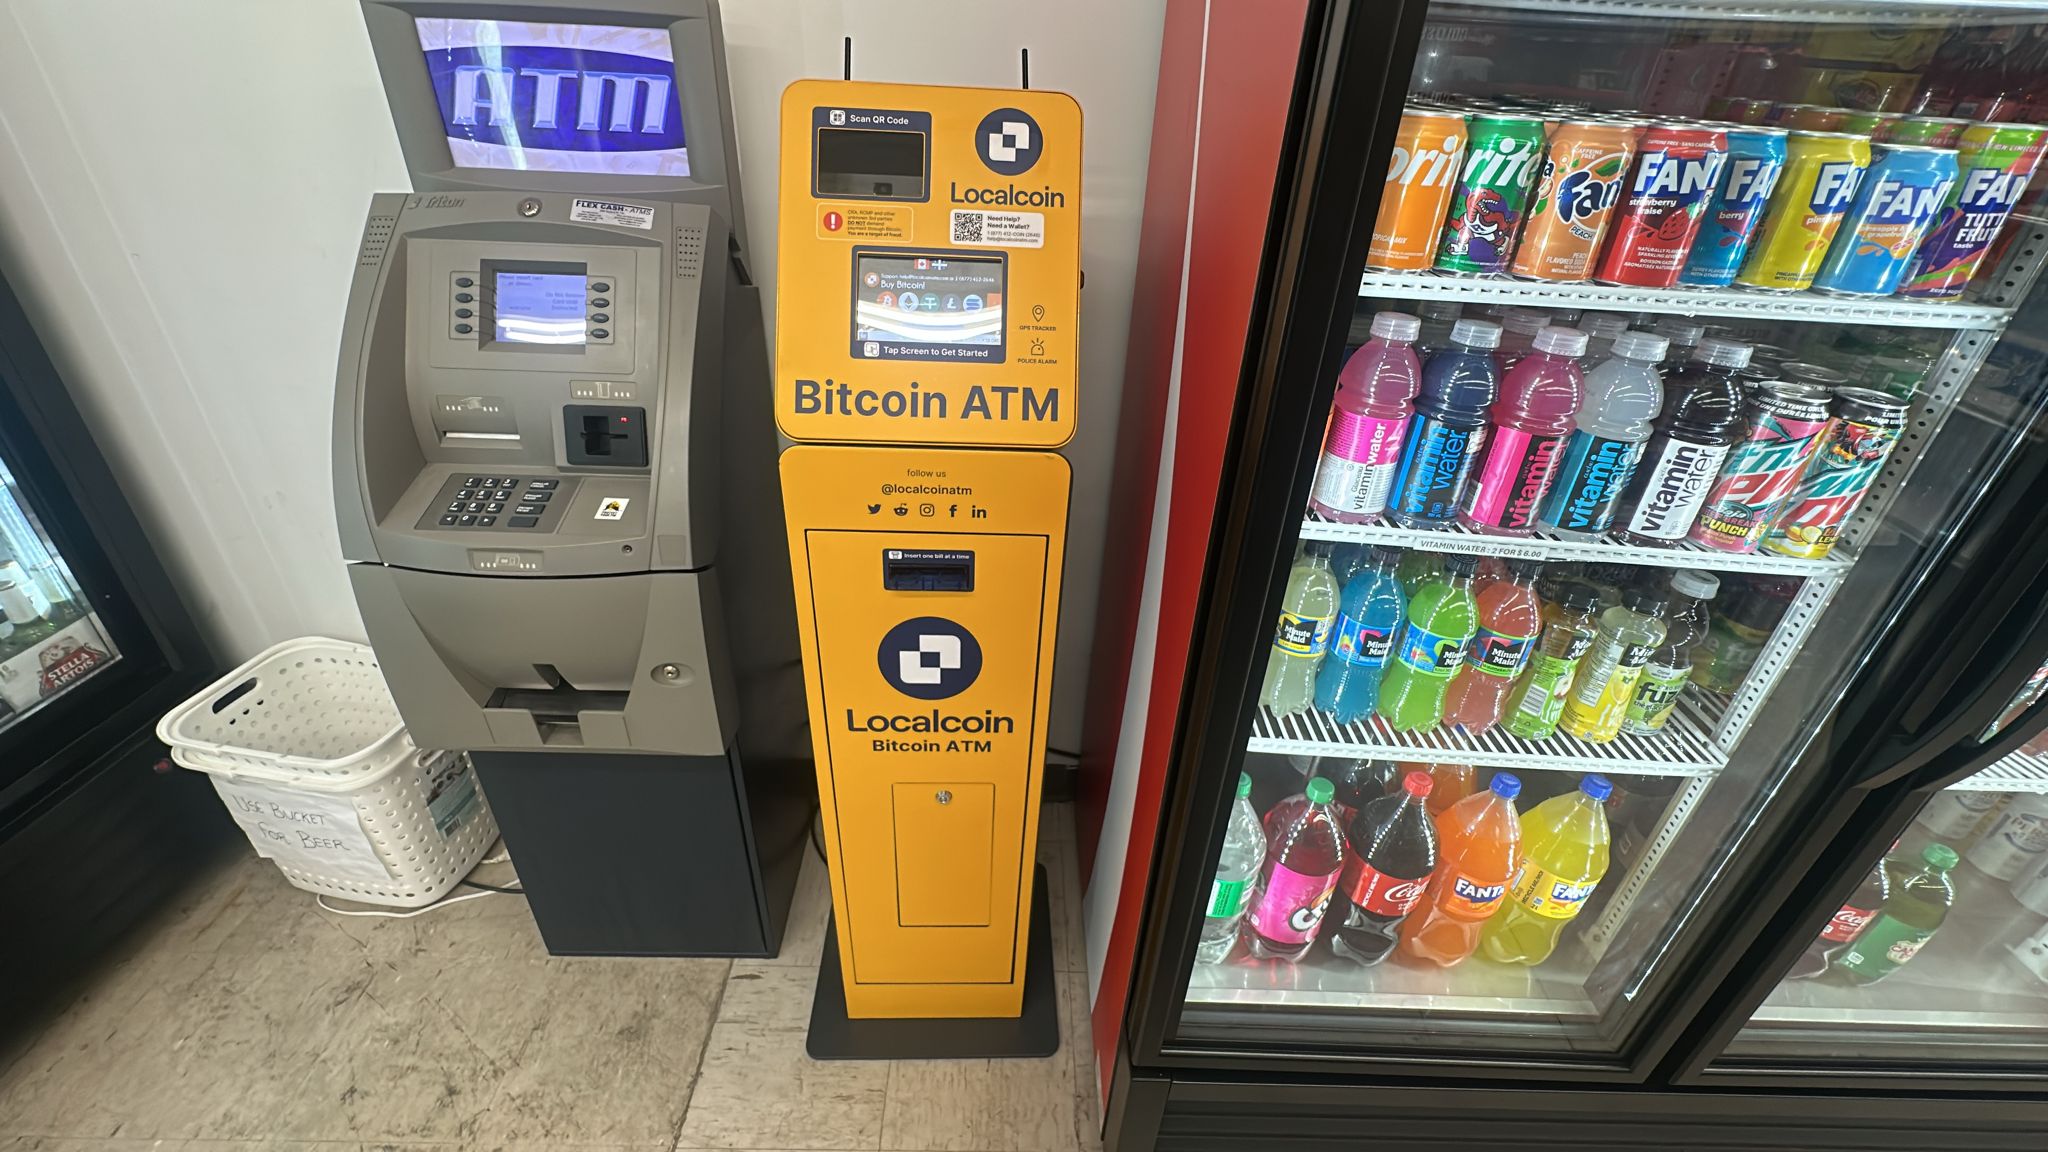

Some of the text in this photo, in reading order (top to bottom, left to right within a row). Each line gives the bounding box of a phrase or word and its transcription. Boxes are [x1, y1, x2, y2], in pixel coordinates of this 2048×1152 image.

[452, 65, 672, 135] ATM
[850, 114, 909, 125] Scan QR Code
[951, 182, 1065, 208] Localcoin
[576, 200, 598, 209] FLEX
[600, 204, 624, 212] CASH
[630, 208, 652, 216] ATMS
[1718, 211, 1745, 221] berry
[1571, 225, 1593, 240] PEACH
[880, 280, 926, 290] Buy Bitcoin!
[883, 346, 989, 358] Tap Screen to Get Started
[794, 378, 1059, 422] Bitcoin ATM
[907, 468, 947, 478] follow us
[1673, 449, 1716, 508] water
[881, 484, 972, 496] @localcoinatm
[1508, 440, 1558, 528] vitamin
[1568, 441, 1624, 528] vitamin
[1640, 446, 1699, 531] vitamin
[1701, 514, 1749, 537] PUNCH
[1421, 540, 1456, 551] VITAMIN
[1457, 543, 1486, 553] WATER
[1498, 548, 1516, 556] FOR
[1517, 549, 1522, 557] $
[1523, 550, 1542, 558] 6.00
[1284, 625, 1311, 638] Minute
[1285, 632, 1306, 644] Maid
[1491, 648, 1521, 659] Minute
[1492, 656, 1516, 666] Maid
[48, 651, 91, 681] STELLA
[53, 658, 95, 689] ARTOIS
[846, 709, 1014, 734] Localcoin
[872, 739, 992, 754] Bitcoin ATM
[232, 794, 328, 826] USE BUCKET
[258, 821, 351, 851] FOR BEER
